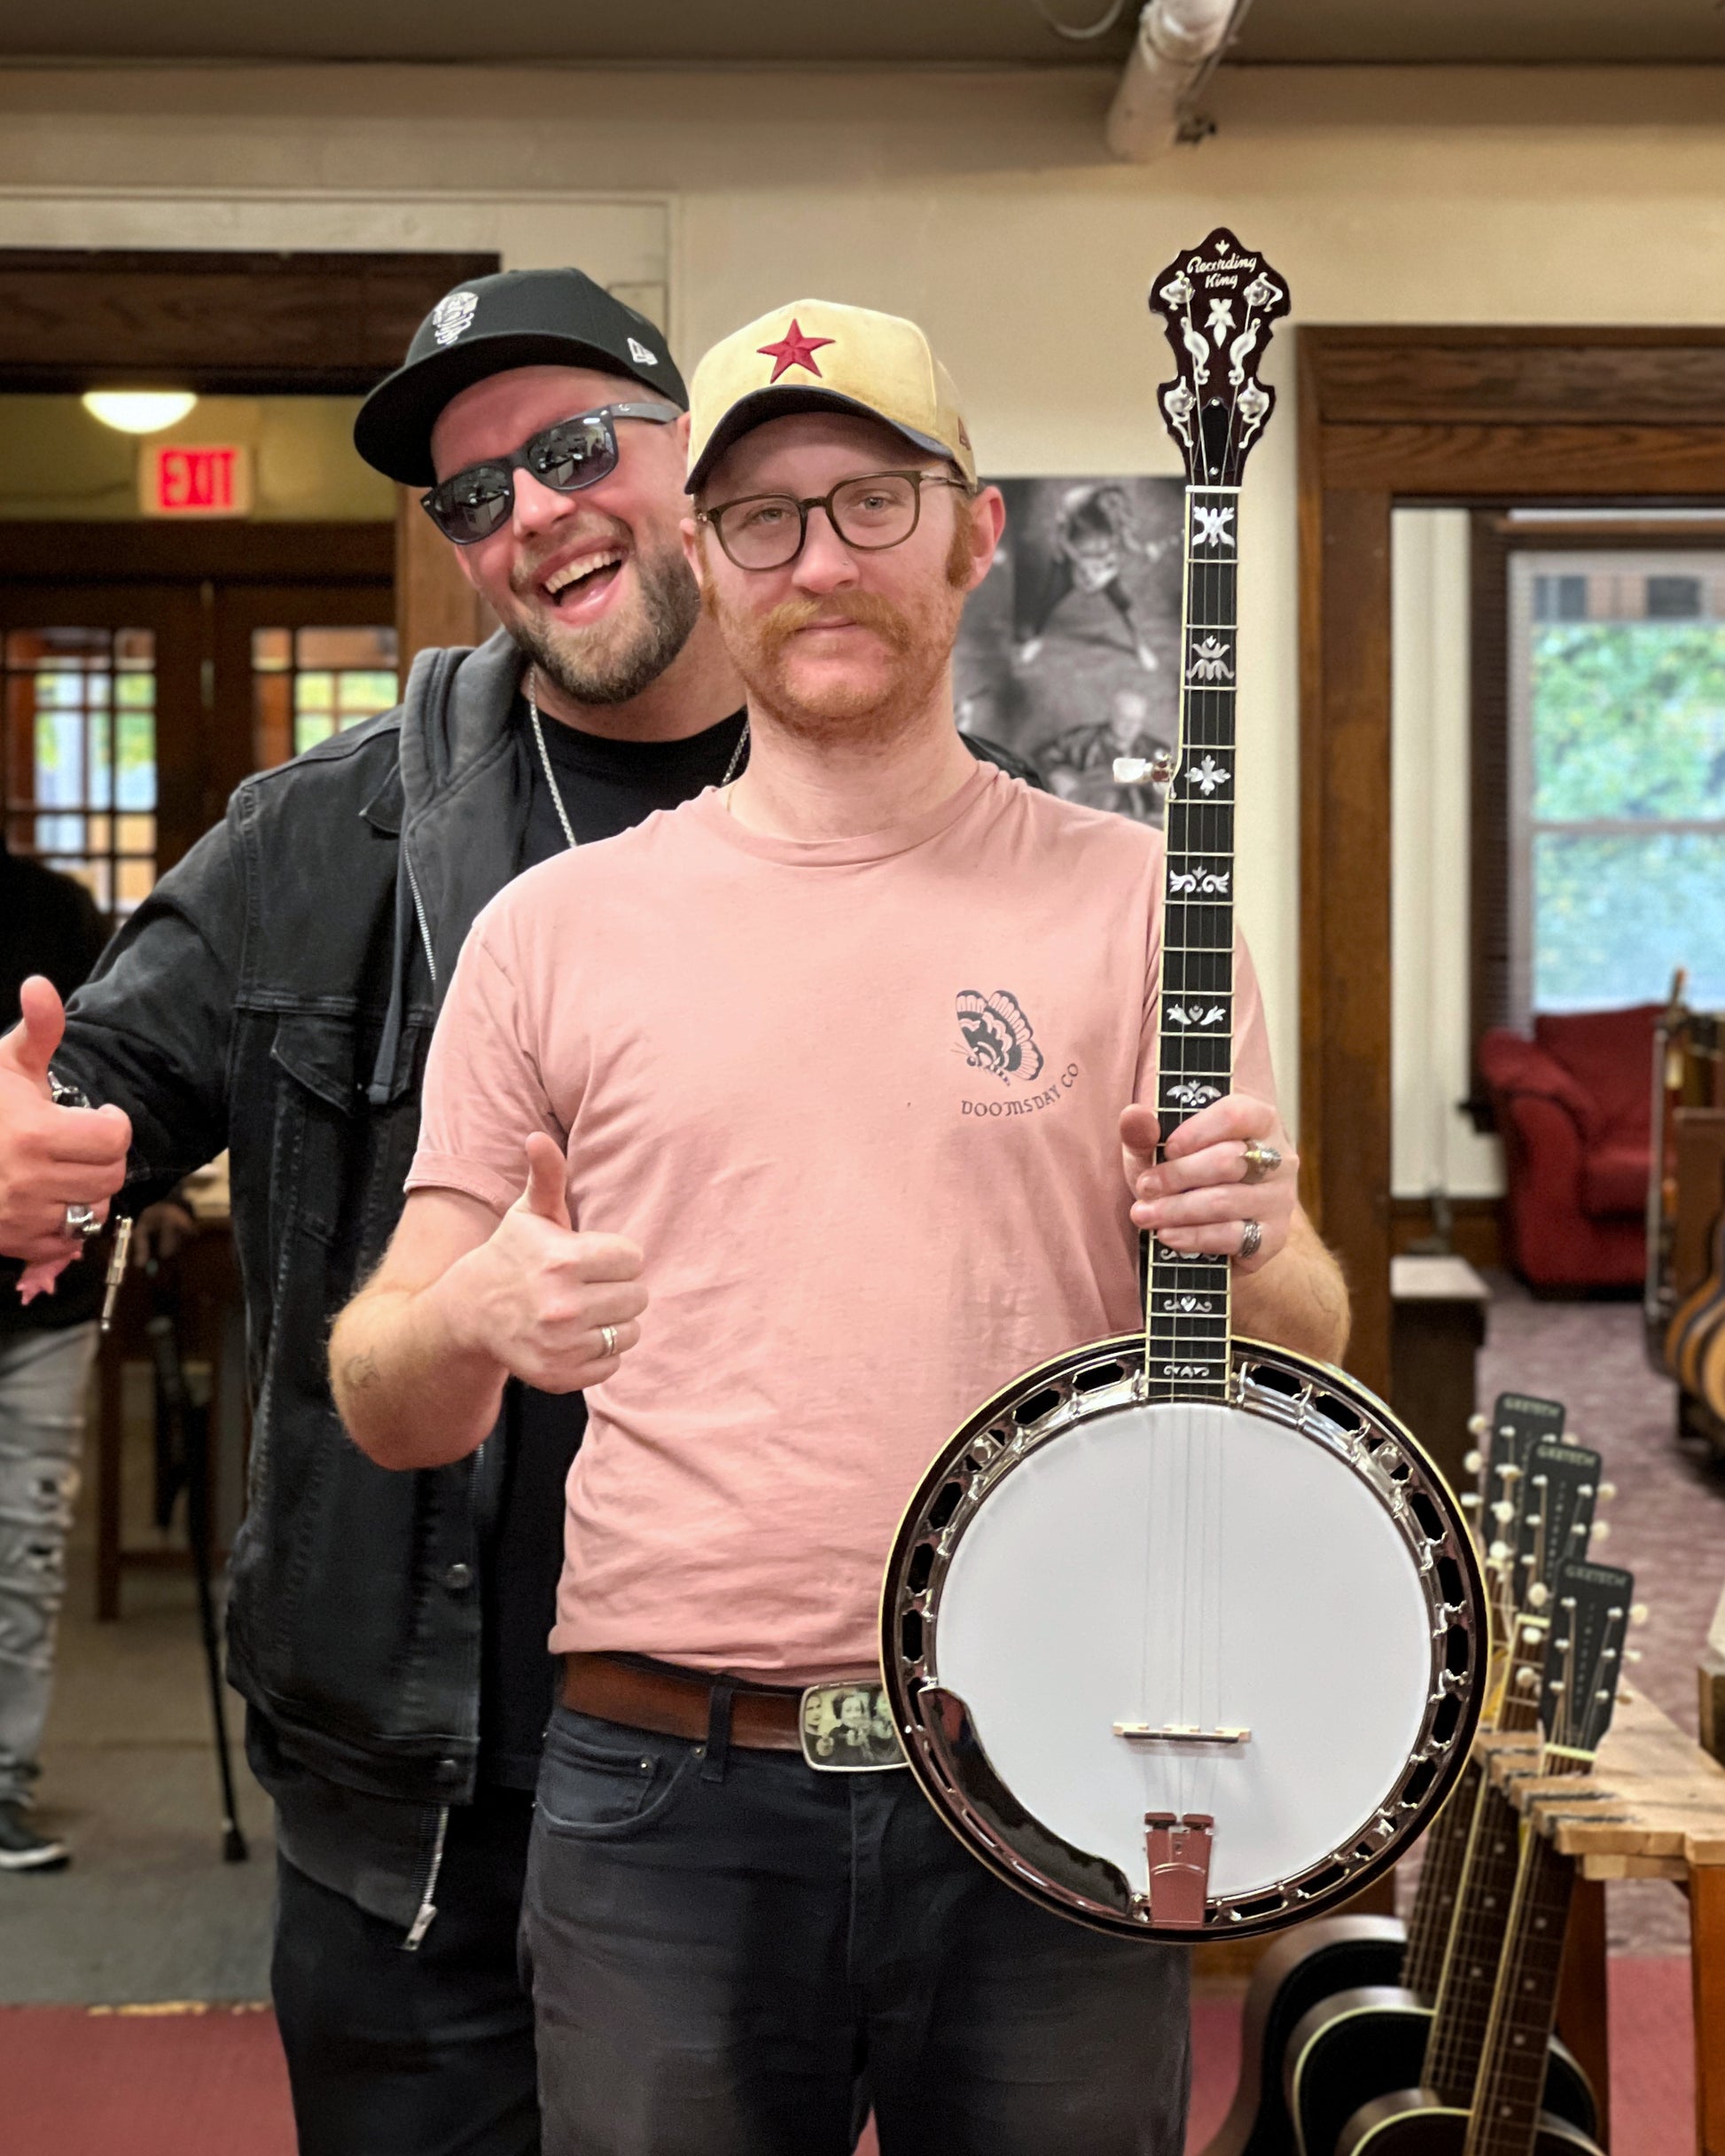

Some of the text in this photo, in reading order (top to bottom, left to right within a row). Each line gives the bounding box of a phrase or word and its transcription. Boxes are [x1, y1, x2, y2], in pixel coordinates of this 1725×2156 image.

[1187, 253, 1257, 273] Recording
[1205, 273, 1238, 289] King
[161, 450, 232, 507] EXIT
[961, 1063, 1079, 1117] DOOMSDAY CO
